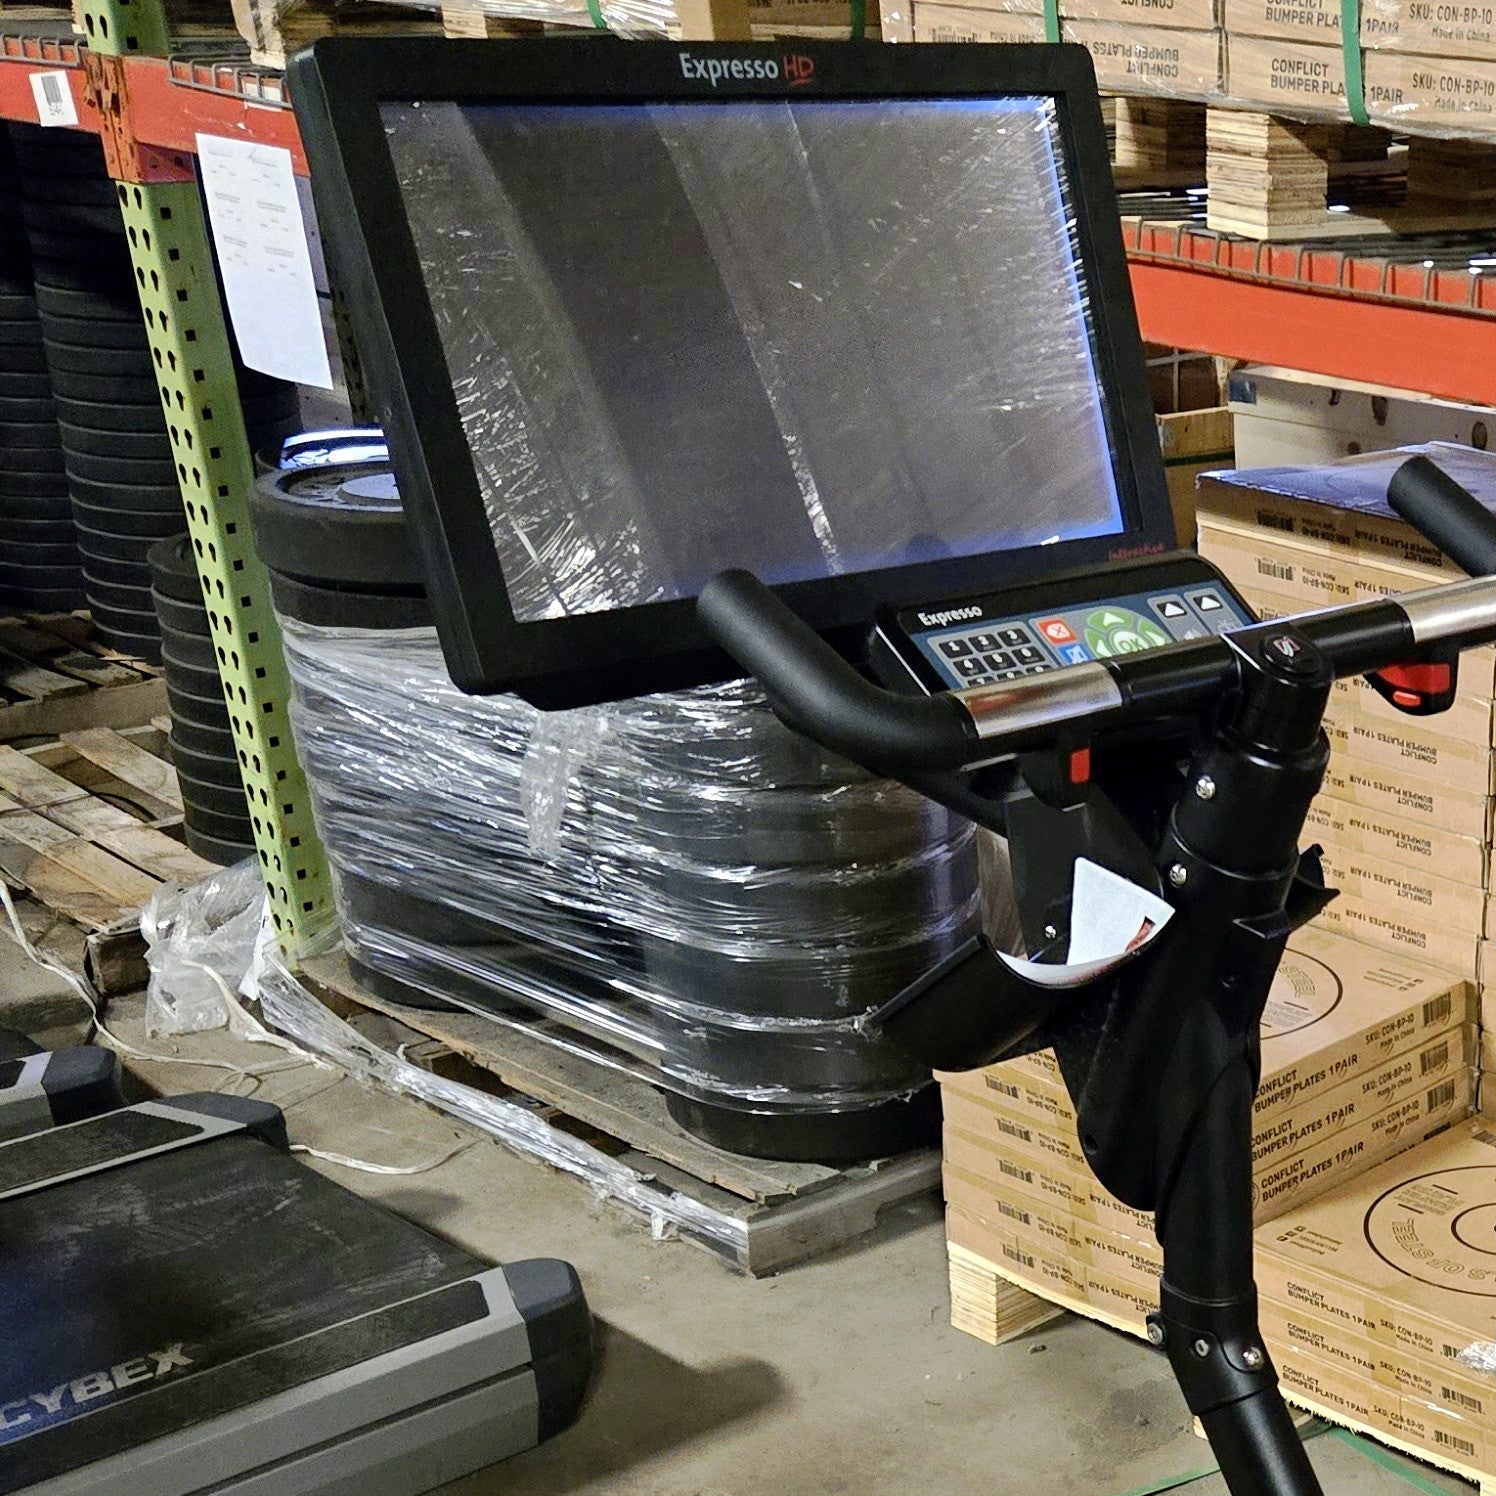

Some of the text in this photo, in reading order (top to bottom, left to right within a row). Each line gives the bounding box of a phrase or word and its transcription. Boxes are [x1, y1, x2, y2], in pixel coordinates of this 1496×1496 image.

[1266, 6, 1313, 26] BUMPER
[1437, 5, 1492, 25] CON-BP-10
[679, 53, 815, 87] Expresso HD
[1271, 57, 1328, 78] CONFLICT
[1270, 74, 1319, 93] BUMPER
[1439, 76, 1494, 96] CON-BP-10
[918, 605, 983, 628] Expresso
[1118, 637, 1146, 652] OK
[1373, 780, 1400, 795] PLATES
[1402, 788, 1432, 804] BUMPER
[1397, 795, 1433, 813] CONFLICT
[1373, 872, 1400, 888] PLATES
[1402, 881, 1432, 897] BUMPER
[1396, 888, 1432, 906] CONFLICT
[1261, 1158, 1303, 1189] CONFLICT
[1262, 1174, 1298, 1202] BUMPER
[1300, 1156, 1332, 1182] PLATES
[1392, 1218, 1434, 1262] STEEL
[1426, 1259, 1465, 1275] OF
[1287, 1320, 1324, 1343] CONFLICT
[1288, 1329, 1319, 1349] BUMPER
[1321, 1342, 1350, 1361] PLATES
[0, 1342, 194, 1430] CYBEX
